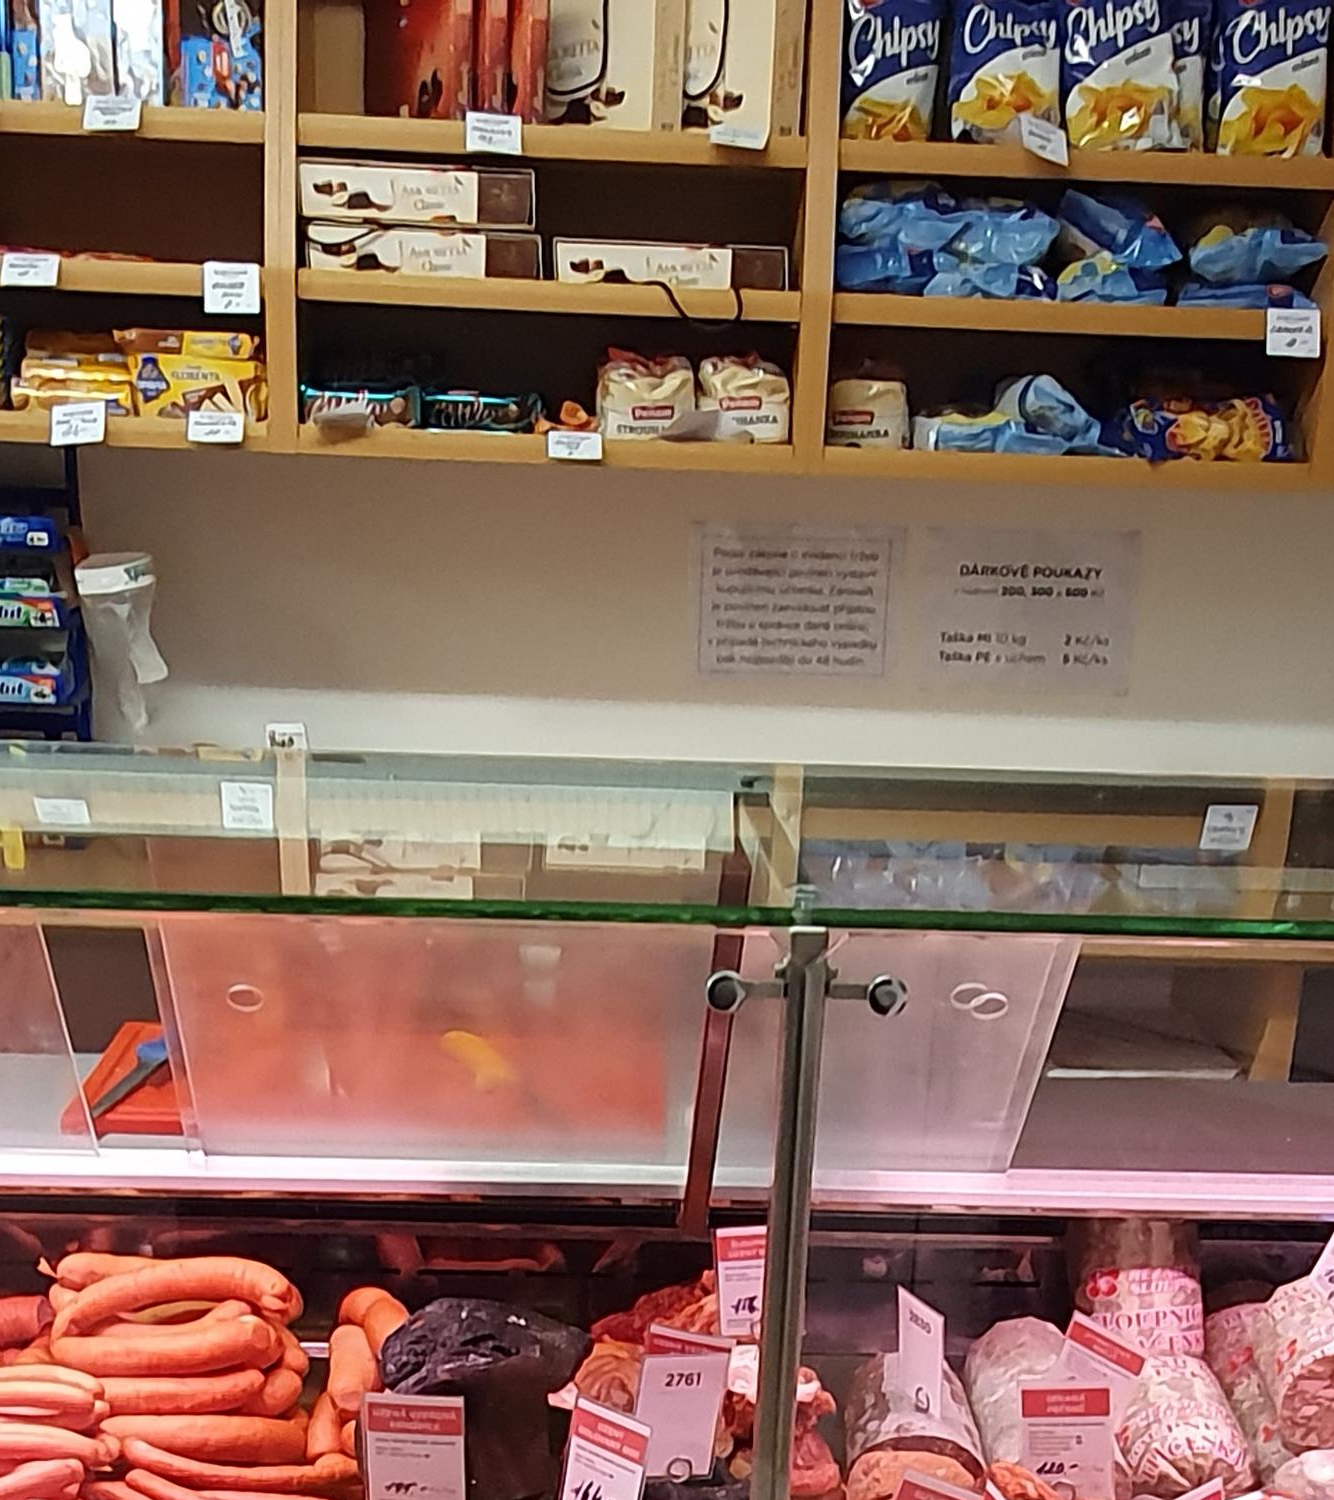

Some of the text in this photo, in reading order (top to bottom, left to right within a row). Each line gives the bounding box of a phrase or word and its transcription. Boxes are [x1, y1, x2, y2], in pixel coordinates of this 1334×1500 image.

[849, 13, 940, 70] Chipsy
[964, 4, 1057, 53] Chipsy
[1065, 0, 1161, 64] Chipsy
[1233, 7, 1331, 63] Chipsy
[959, 563, 1102, 580] DÁRKOVÉ POUKAZY
[664, 1371, 702, 1387] 2761
